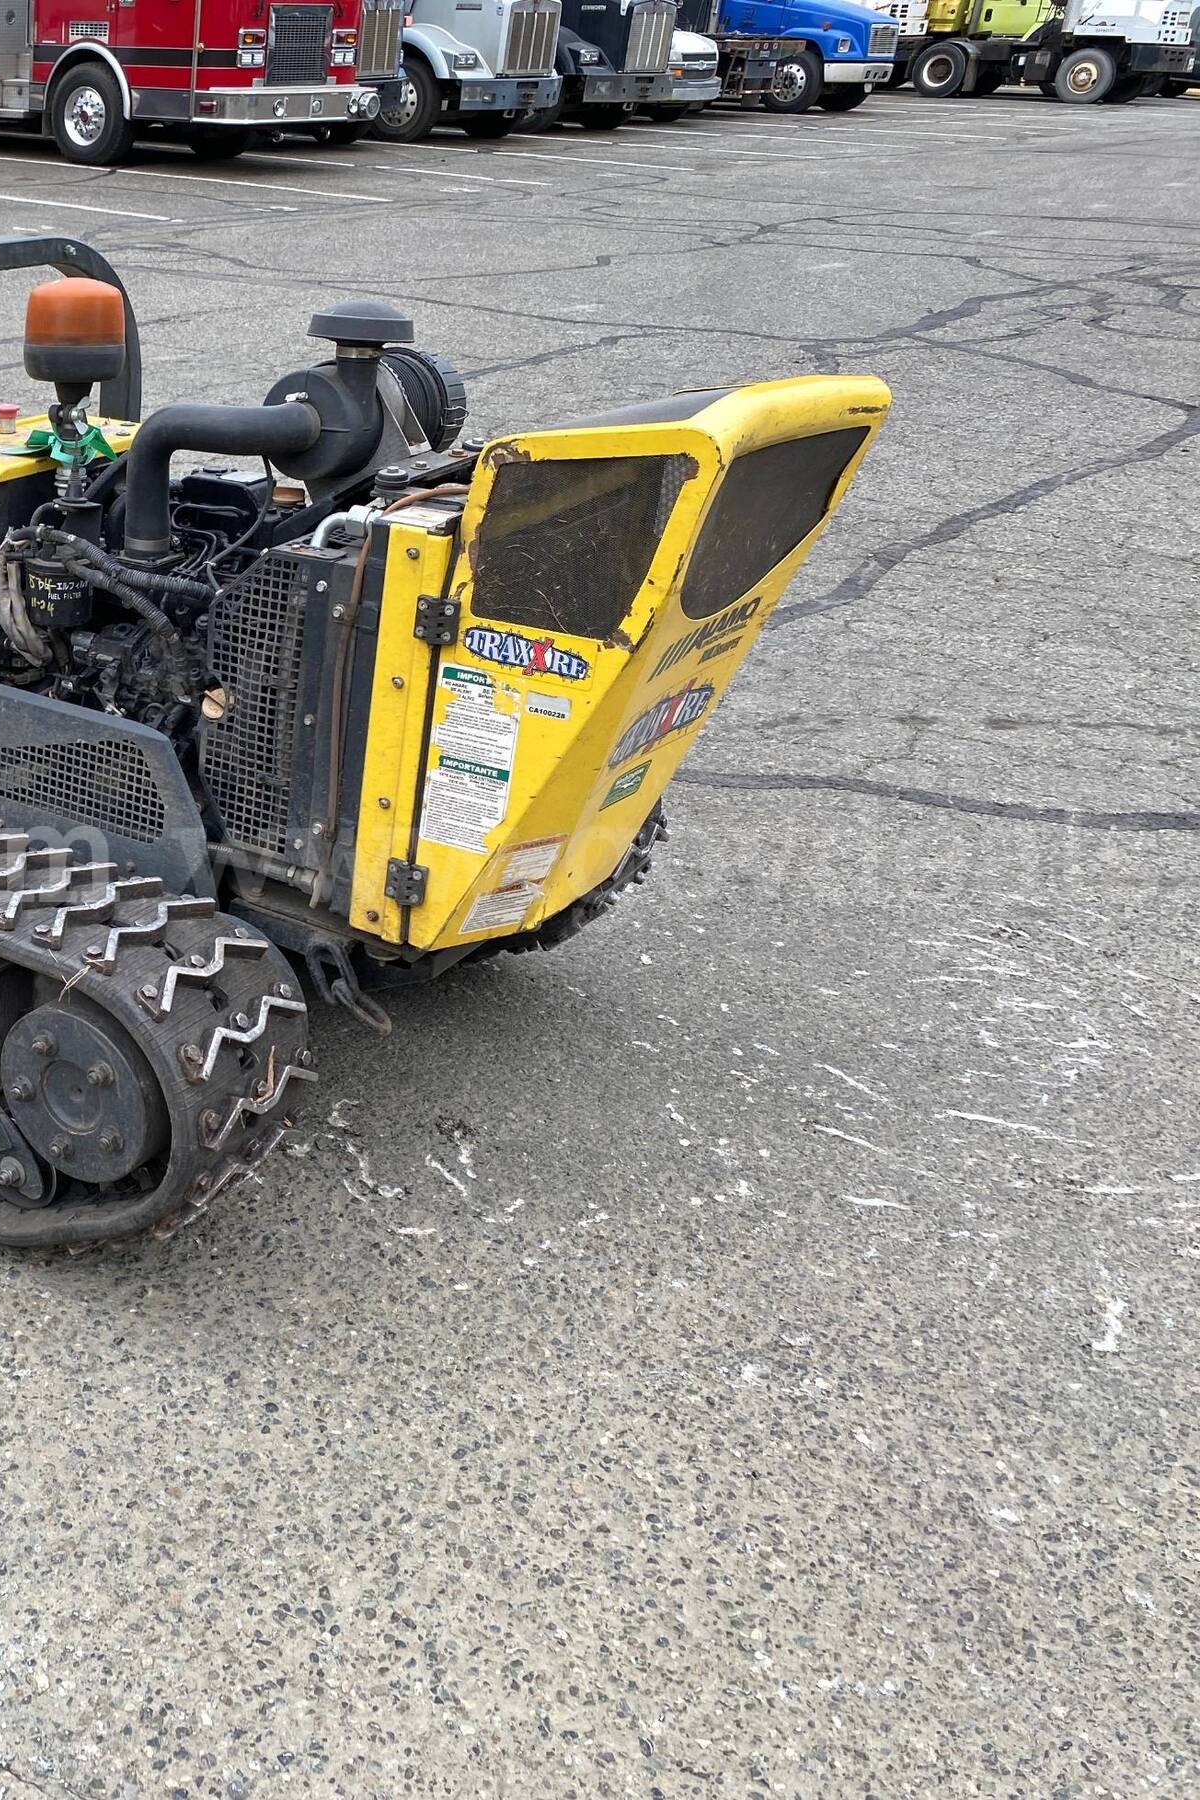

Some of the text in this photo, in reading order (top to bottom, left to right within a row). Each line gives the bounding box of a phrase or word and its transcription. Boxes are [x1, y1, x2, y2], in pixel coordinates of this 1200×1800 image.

[48, 590, 82, 600] FUEL FILTER
[442, 757, 498, 778] IMPORTANTE
